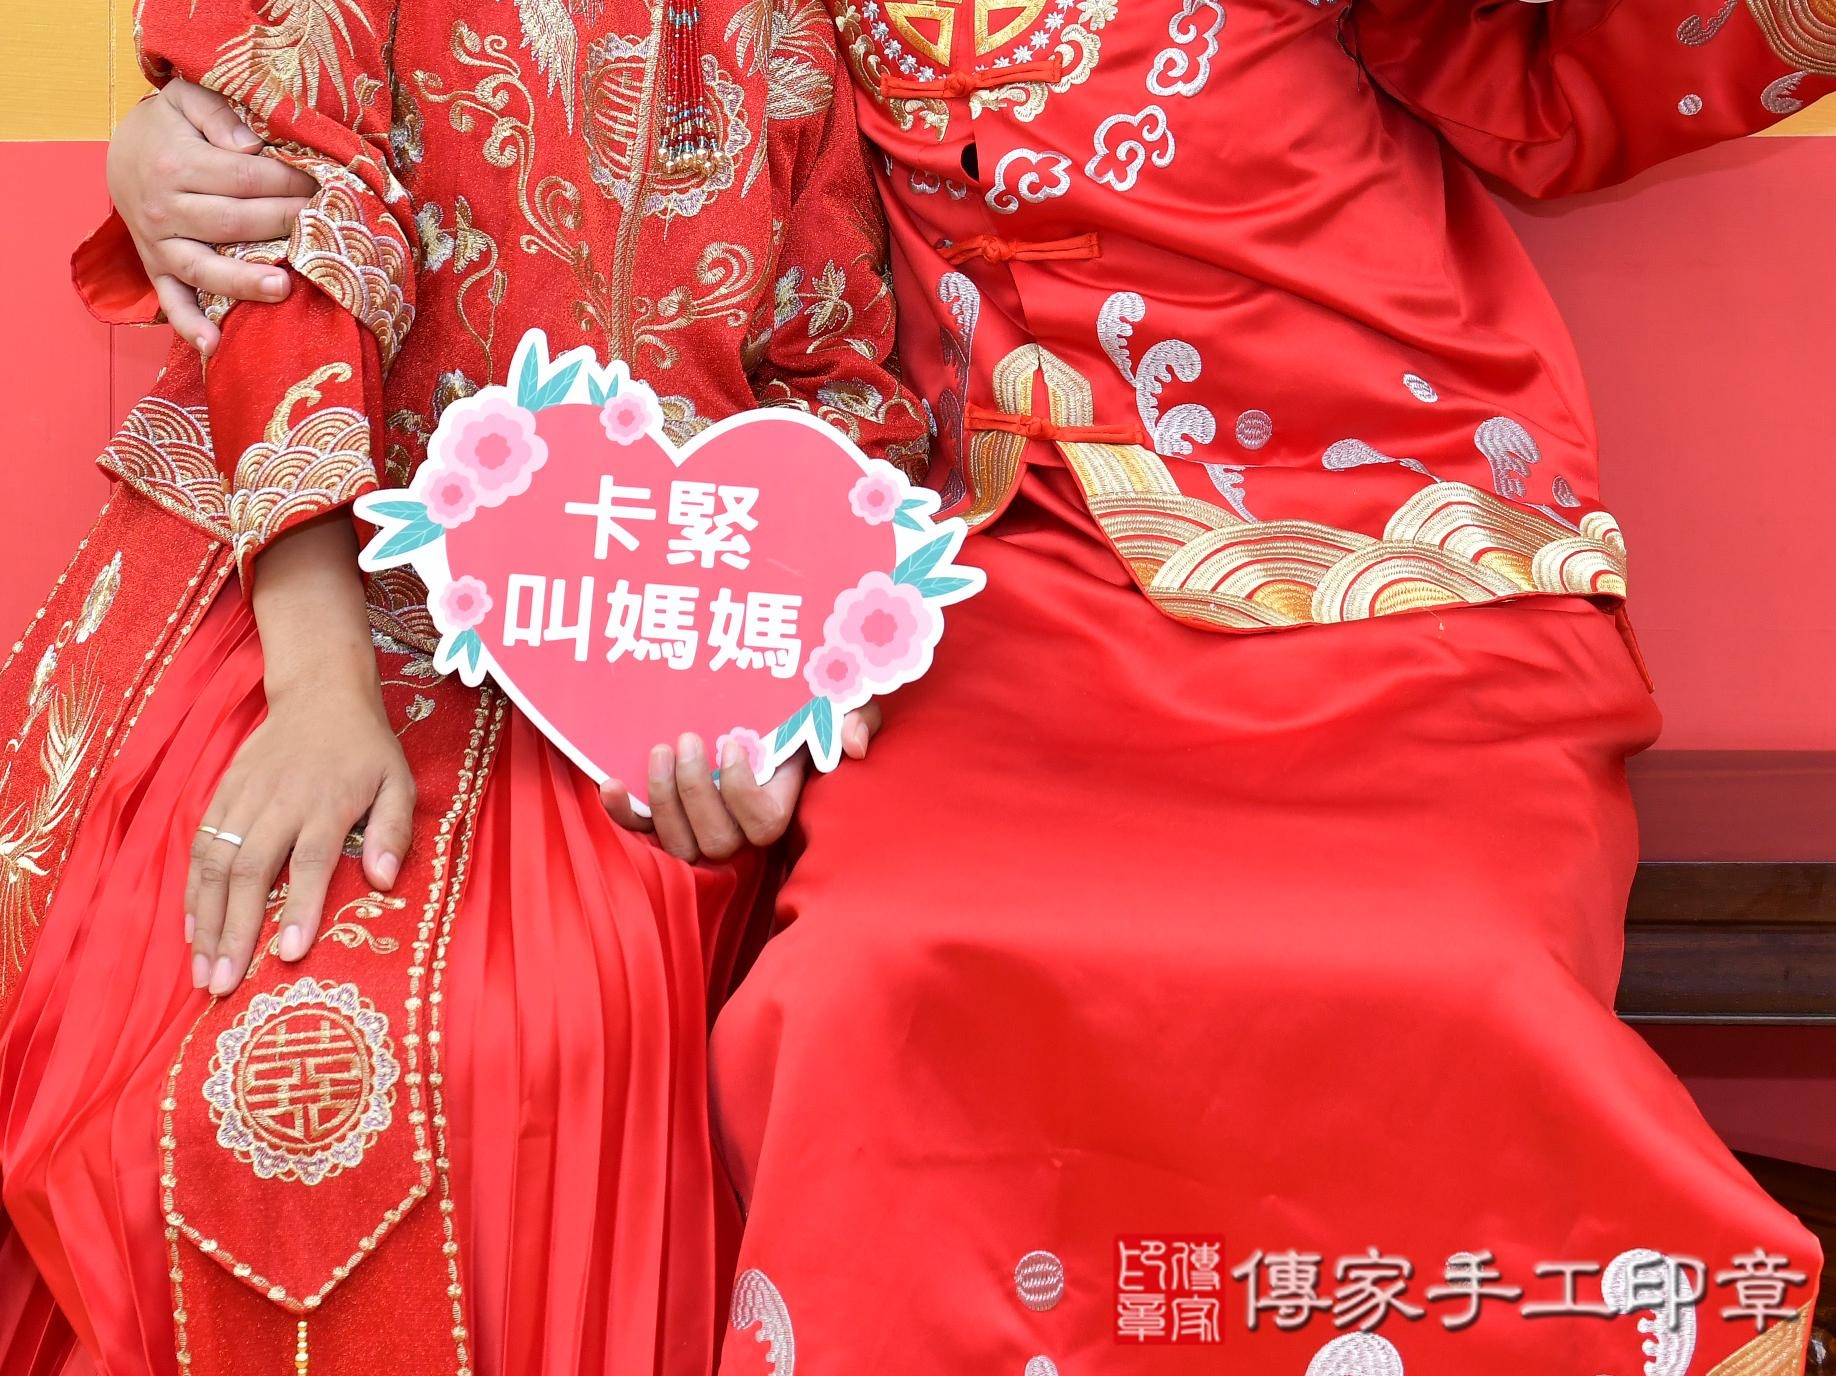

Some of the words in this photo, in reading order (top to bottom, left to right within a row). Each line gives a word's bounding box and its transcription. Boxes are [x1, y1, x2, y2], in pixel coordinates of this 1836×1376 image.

[564, 475, 760, 570] 卡緊
[502, 573, 803, 680] 叫媽媽
